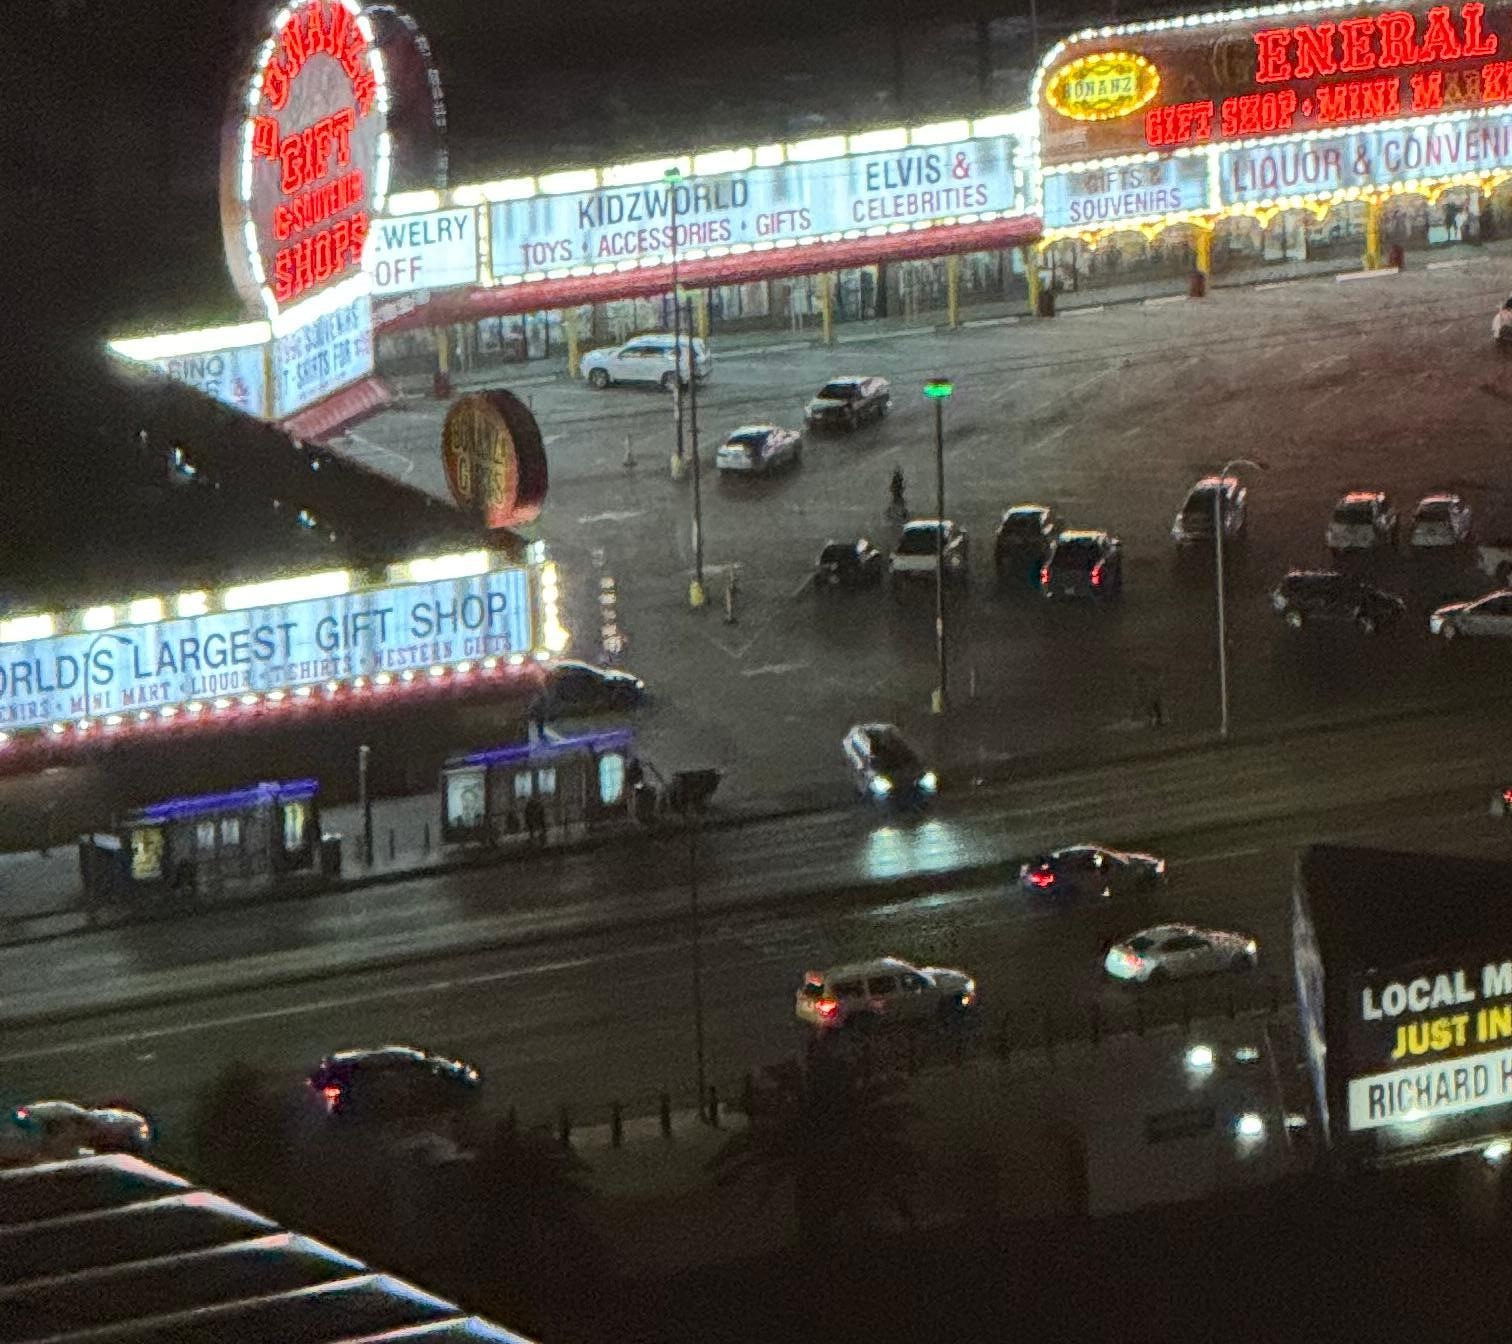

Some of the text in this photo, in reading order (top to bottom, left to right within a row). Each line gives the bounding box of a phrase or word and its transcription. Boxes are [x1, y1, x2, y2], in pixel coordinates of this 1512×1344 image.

[1145, 99, 1215, 147] GIFT
[1221, 89, 1297, 138] SHOP
[1316, 76, 1400, 123] MINI
[279, 108, 357, 194] GIFT
[866, 151, 970, 192] ELVIS &
[1234, 148, 1342, 193] LIQUOR
[1353, 143, 1370, 176] &
[578, 178, 748, 230] KIDZWORLD
[852, 183, 989, 224] CELEBRITIES
[1070, 187, 1182, 223] SOUVENIRS
[275, 210, 369, 304] SHOPS
[375, 214, 469, 251] WELRY
[522, 208, 811, 266] TOYS ACCESSORIES GIFTS
[375, 255, 422, 287] OFF
[133, 622, 298, 680] LARGEST
[315, 607, 393, 652] GIFT
[410, 592, 508, 638] SHOP
[1362, 969, 1476, 1021] LOCAL
[1390, 1014, 1468, 1060] JUST
[1477, 1004, 1512, 1043] IN
[1367, 1062, 1491, 1121] RICHARD
